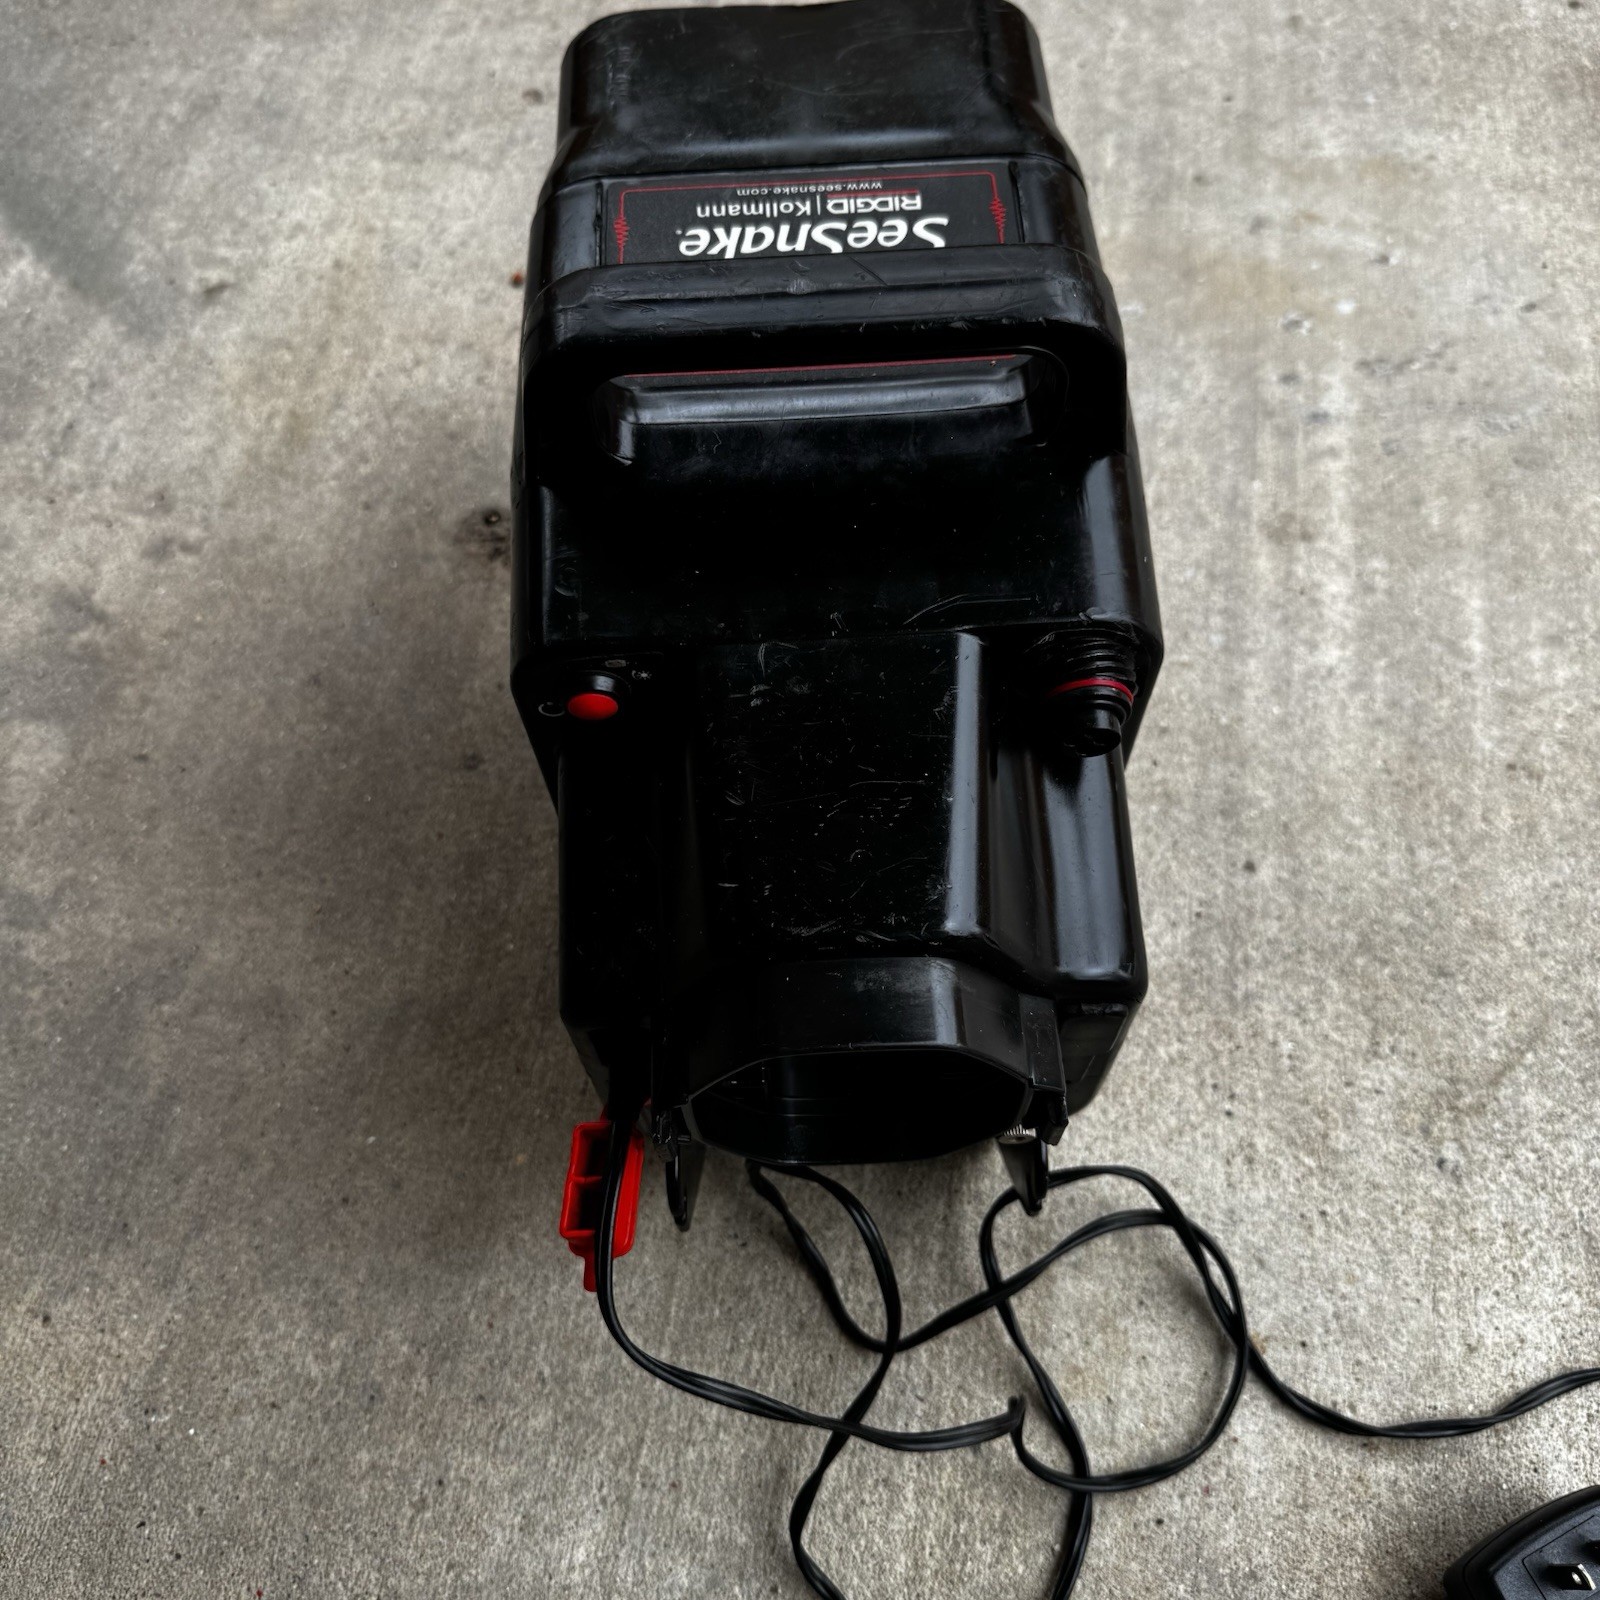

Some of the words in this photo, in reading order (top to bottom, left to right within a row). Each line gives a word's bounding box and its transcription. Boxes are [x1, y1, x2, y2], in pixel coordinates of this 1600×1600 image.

[736, 181, 883, 197] www.seesnake.com
[696, 199, 811, 218] Kollmann
[827, 193, 922, 214] RIDGID
